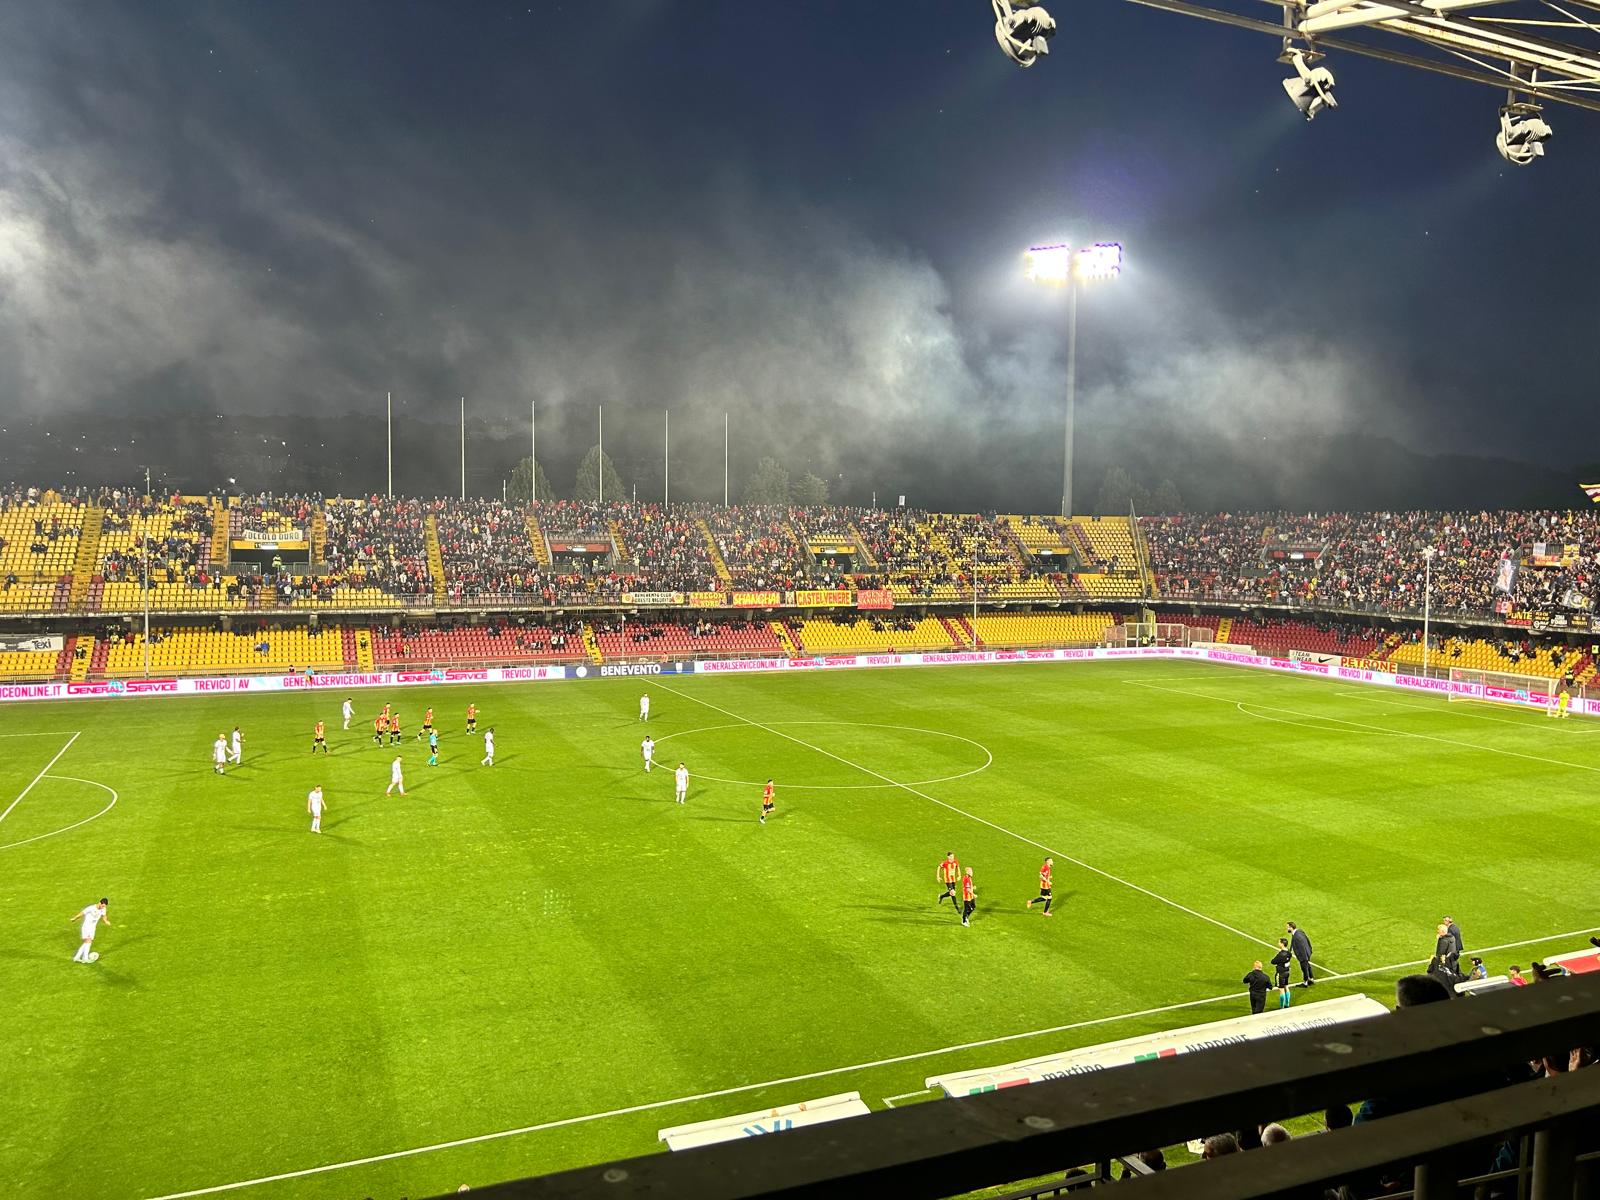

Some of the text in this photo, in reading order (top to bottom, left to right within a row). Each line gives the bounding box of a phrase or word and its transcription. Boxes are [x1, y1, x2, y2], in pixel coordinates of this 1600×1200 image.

[32, 639, 51, 650] Texi
[922, 652, 992, 662] GENERALSERVICEONLINE.IT
[1026, 650, 1054, 659] SERVICE
[1064, 650, 1083, 658] TREVICO
[704, 661, 785, 671] GENERALSERVICEONLINE.IT
[825, 656, 856, 666] SERVICE
[867, 656, 902, 665] TREVICO AV
[1341, 657, 1396, 674] PETRONE
[501, 669, 547, 679] TREVICO AV
[600, 664, 661, 676] BENEVENTO
[1338, 668, 1360, 679] TREVICO
[1365, 671, 1373, 680] AV
[397, 669, 487, 683] GENERAL SERVICE
[67, 680, 177, 694] GENERAL SERVICE
[194, 680, 249, 692] TREVICO AV
[1041, 1063, 1104, 1081] martino
